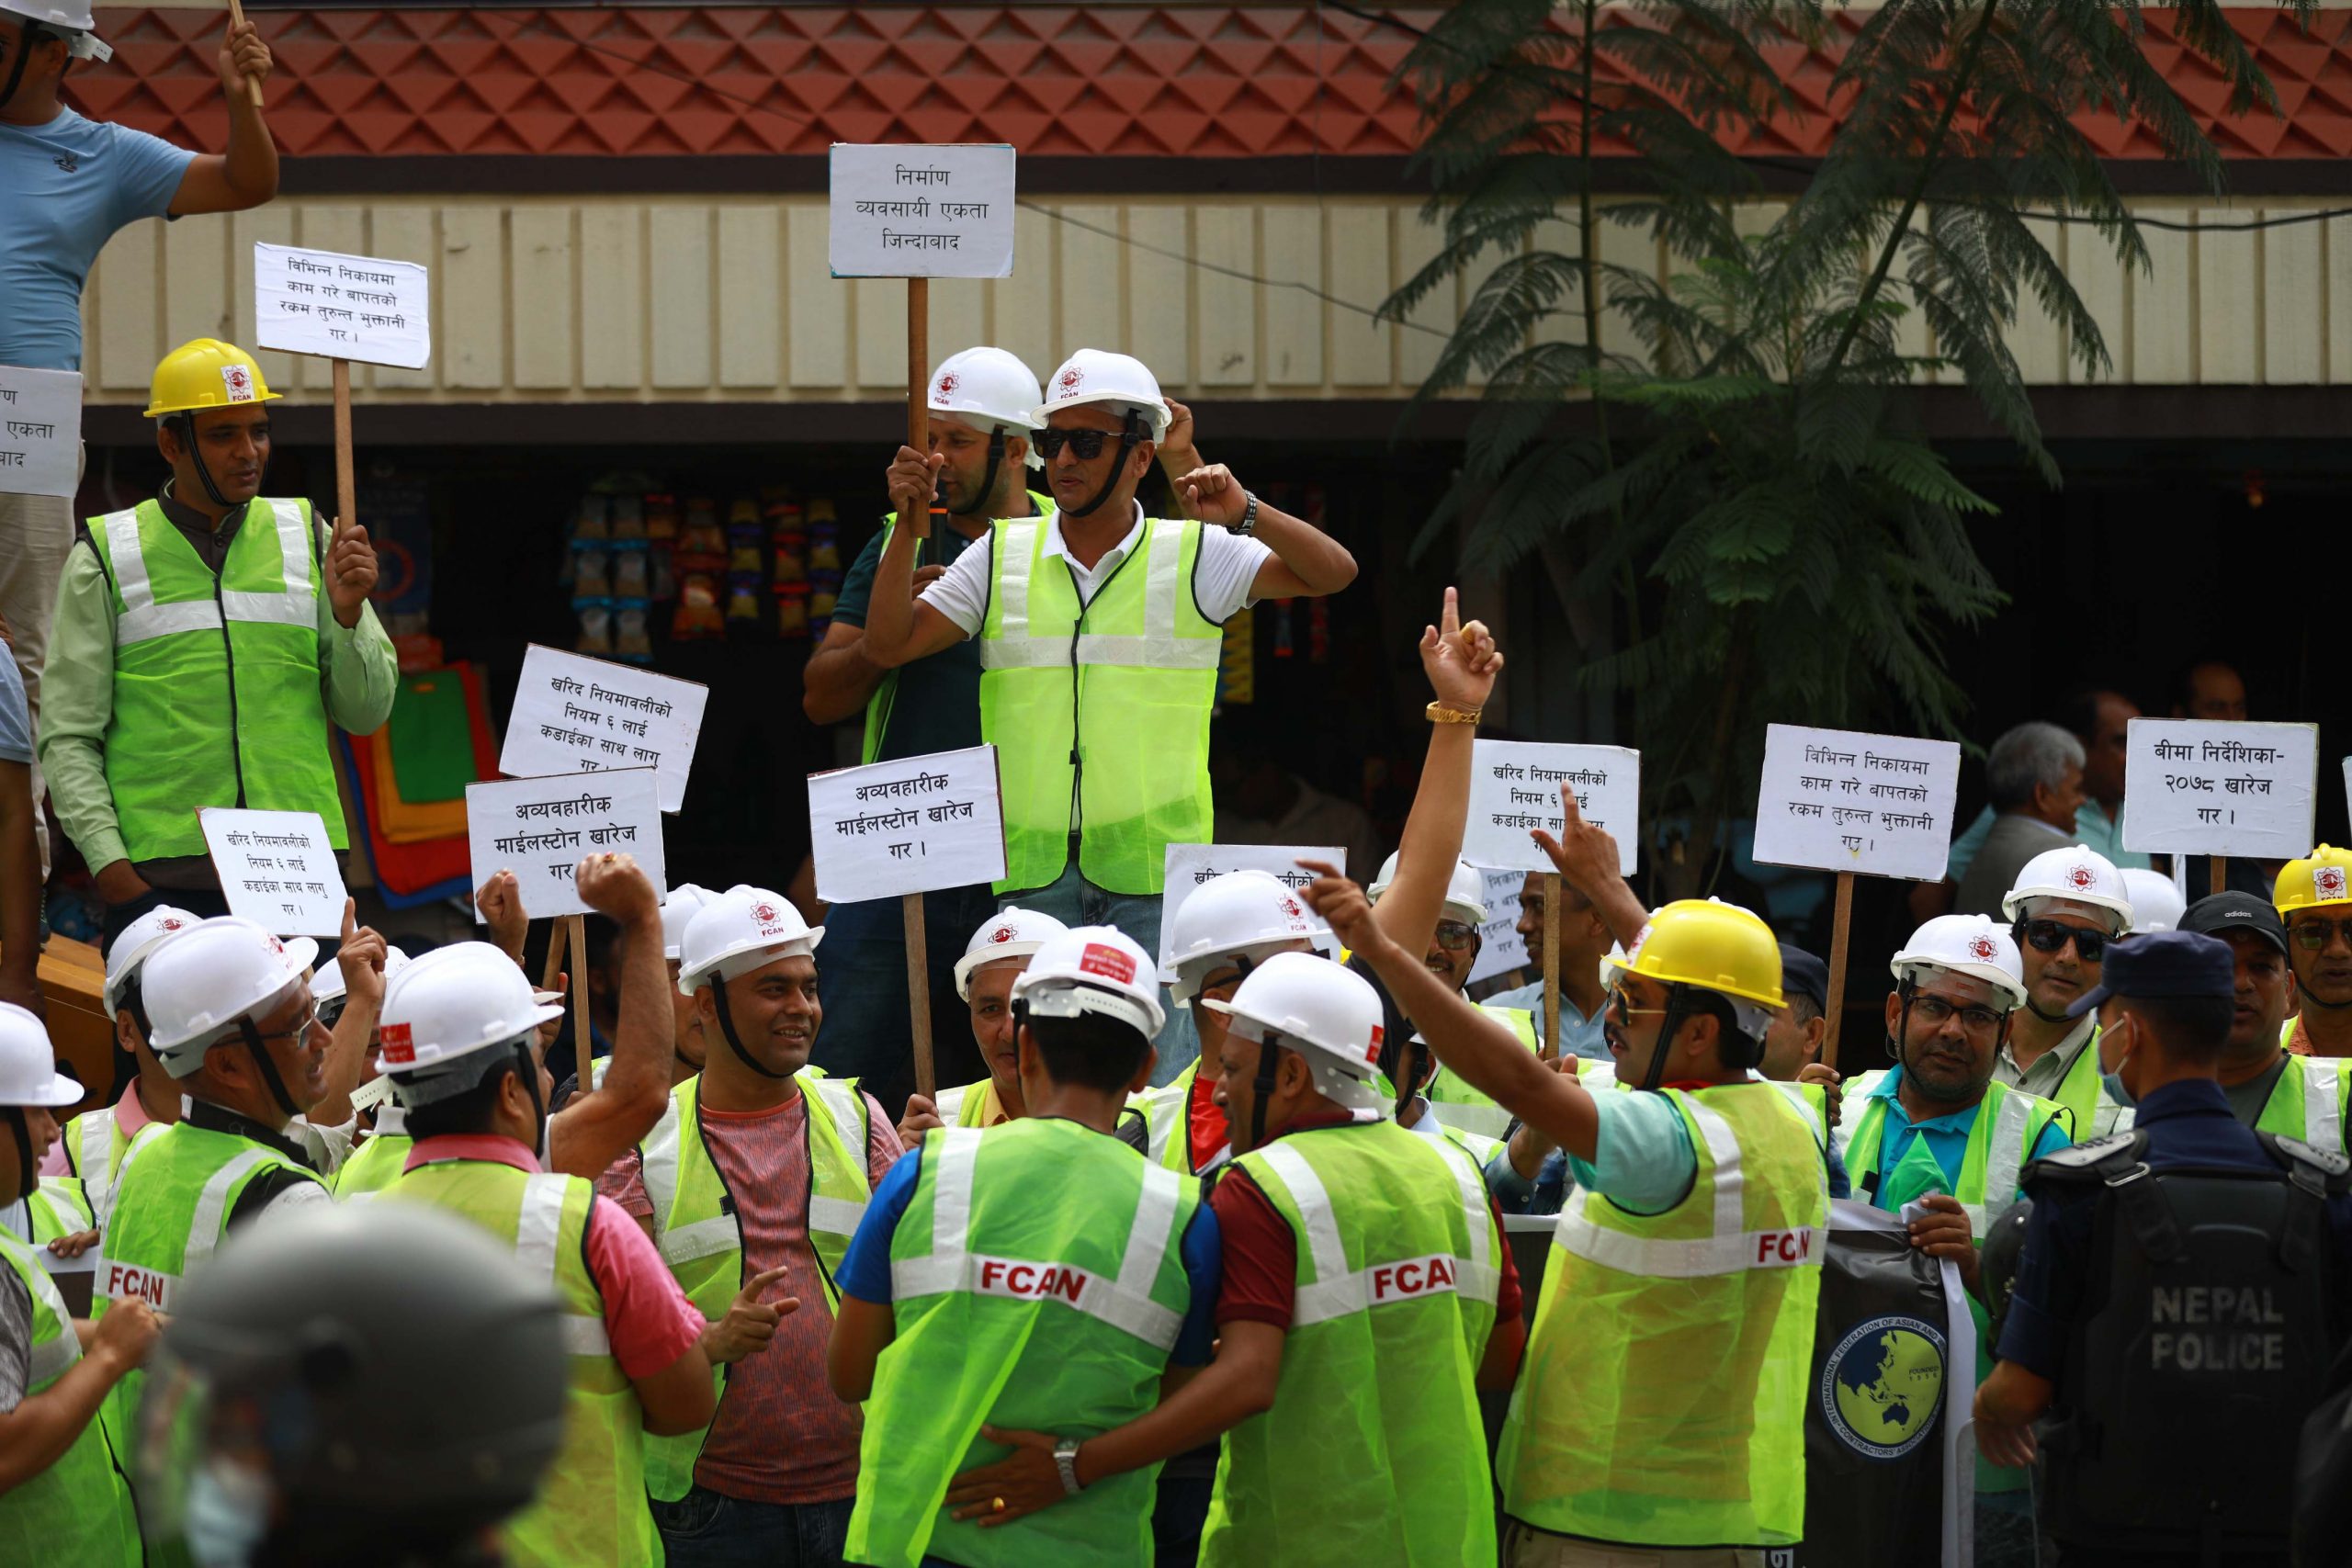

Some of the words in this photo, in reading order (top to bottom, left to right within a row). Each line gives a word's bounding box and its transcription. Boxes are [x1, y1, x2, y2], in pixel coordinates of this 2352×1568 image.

[896, 164, 951, 186] निर्माण
[854, 197, 932, 218] व्यवसायी
[941, 203, 989, 221] एकता
[882, 228, 961, 251] जिन्दाबाद
[288, 257, 332, 276] विभिन्न
[339, 265, 395, 286] निकायमा
[287, 280, 314, 294] काम
[322, 285, 340, 299] गरे
[346, 289, 398, 307] बापतको
[279, 299, 311, 314] रकम
[317, 306, 353, 321] तुरुन्त
[360, 312, 405, 329] भुक्तानी
[329, 329, 348, 342] गर
[933, 397, 950, 406] FCAN
[6, 421, 56, 439] एकता
[551, 677, 584, 696] खरिद
[589, 683, 673, 718] नियमावलीको
[564, 702, 602, 725] नियम
[622, 719, 649, 738] लाई
[540, 724, 594, 749] कडाईका
[600, 738, 628, 757] साथ
[633, 747, 662, 768] लागु
[2154, 739, 2194, 761] बीमा
[1805, 744, 1857, 767] विभिन्न
[1864, 750, 1929, 775] निकायमा
[855, 772, 949, 802] अव्यवहारीक
[1493, 763, 1524, 781] खरिद
[1530, 765, 1608, 786] नियमावलीको
[2165, 774, 2215, 794] २०७८
[2224, 773, 2273, 795] खारेज
[1510, 787, 1544, 805] नियम
[1801, 775, 1833, 792] काम
[1840, 777, 1861, 795] गरे
[1869, 784, 1928, 803] बापतको
[515, 793, 612, 820] अव्यवहारीक
[835, 807, 920, 837] माईलस्टोन
[927, 800, 974, 823] खारेज
[1789, 802, 1824, 818] रकम
[1831, 807, 1873, 825] तुरुन्त
[1881, 812, 1934, 831] भुक्तानी
[2197, 808, 2222, 824] गर
[1492, 811, 1542, 829] कडाईका
[226, 829, 251, 847] खरिद
[252, 830, 311, 849] नियमावलीको
[494, 828, 581, 854] माईलस्टोन
[589, 822, 638, 846] खारेज
[246, 853, 274, 870] नियम
[287, 855, 307, 873] लाई
[888, 842, 912, 860] गर
[548, 863, 573, 880] गर
[243, 876, 281, 894] कडाईका
[283, 881, 303, 894] साथ
[306, 882, 328, 899] लागु
[281, 904, 297, 917] गर
[762, 927, 784, 937] FCAN
[108, 1266, 164, 1306] FCAN
[982, 1261, 1087, 1303] FCAN
[1374, 1258, 1456, 1299] FCA
[2152, 1287, 2284, 1323] NEPAL
[1837, 1321, 1881, 1359] FEDERATION
[1882, 1318, 1894, 1326] OF
[1895, 1318, 1921, 1331] ASIAN
[1921, 1325, 1939, 1339] AND
[2152, 1333, 2283, 1371] POLICE
